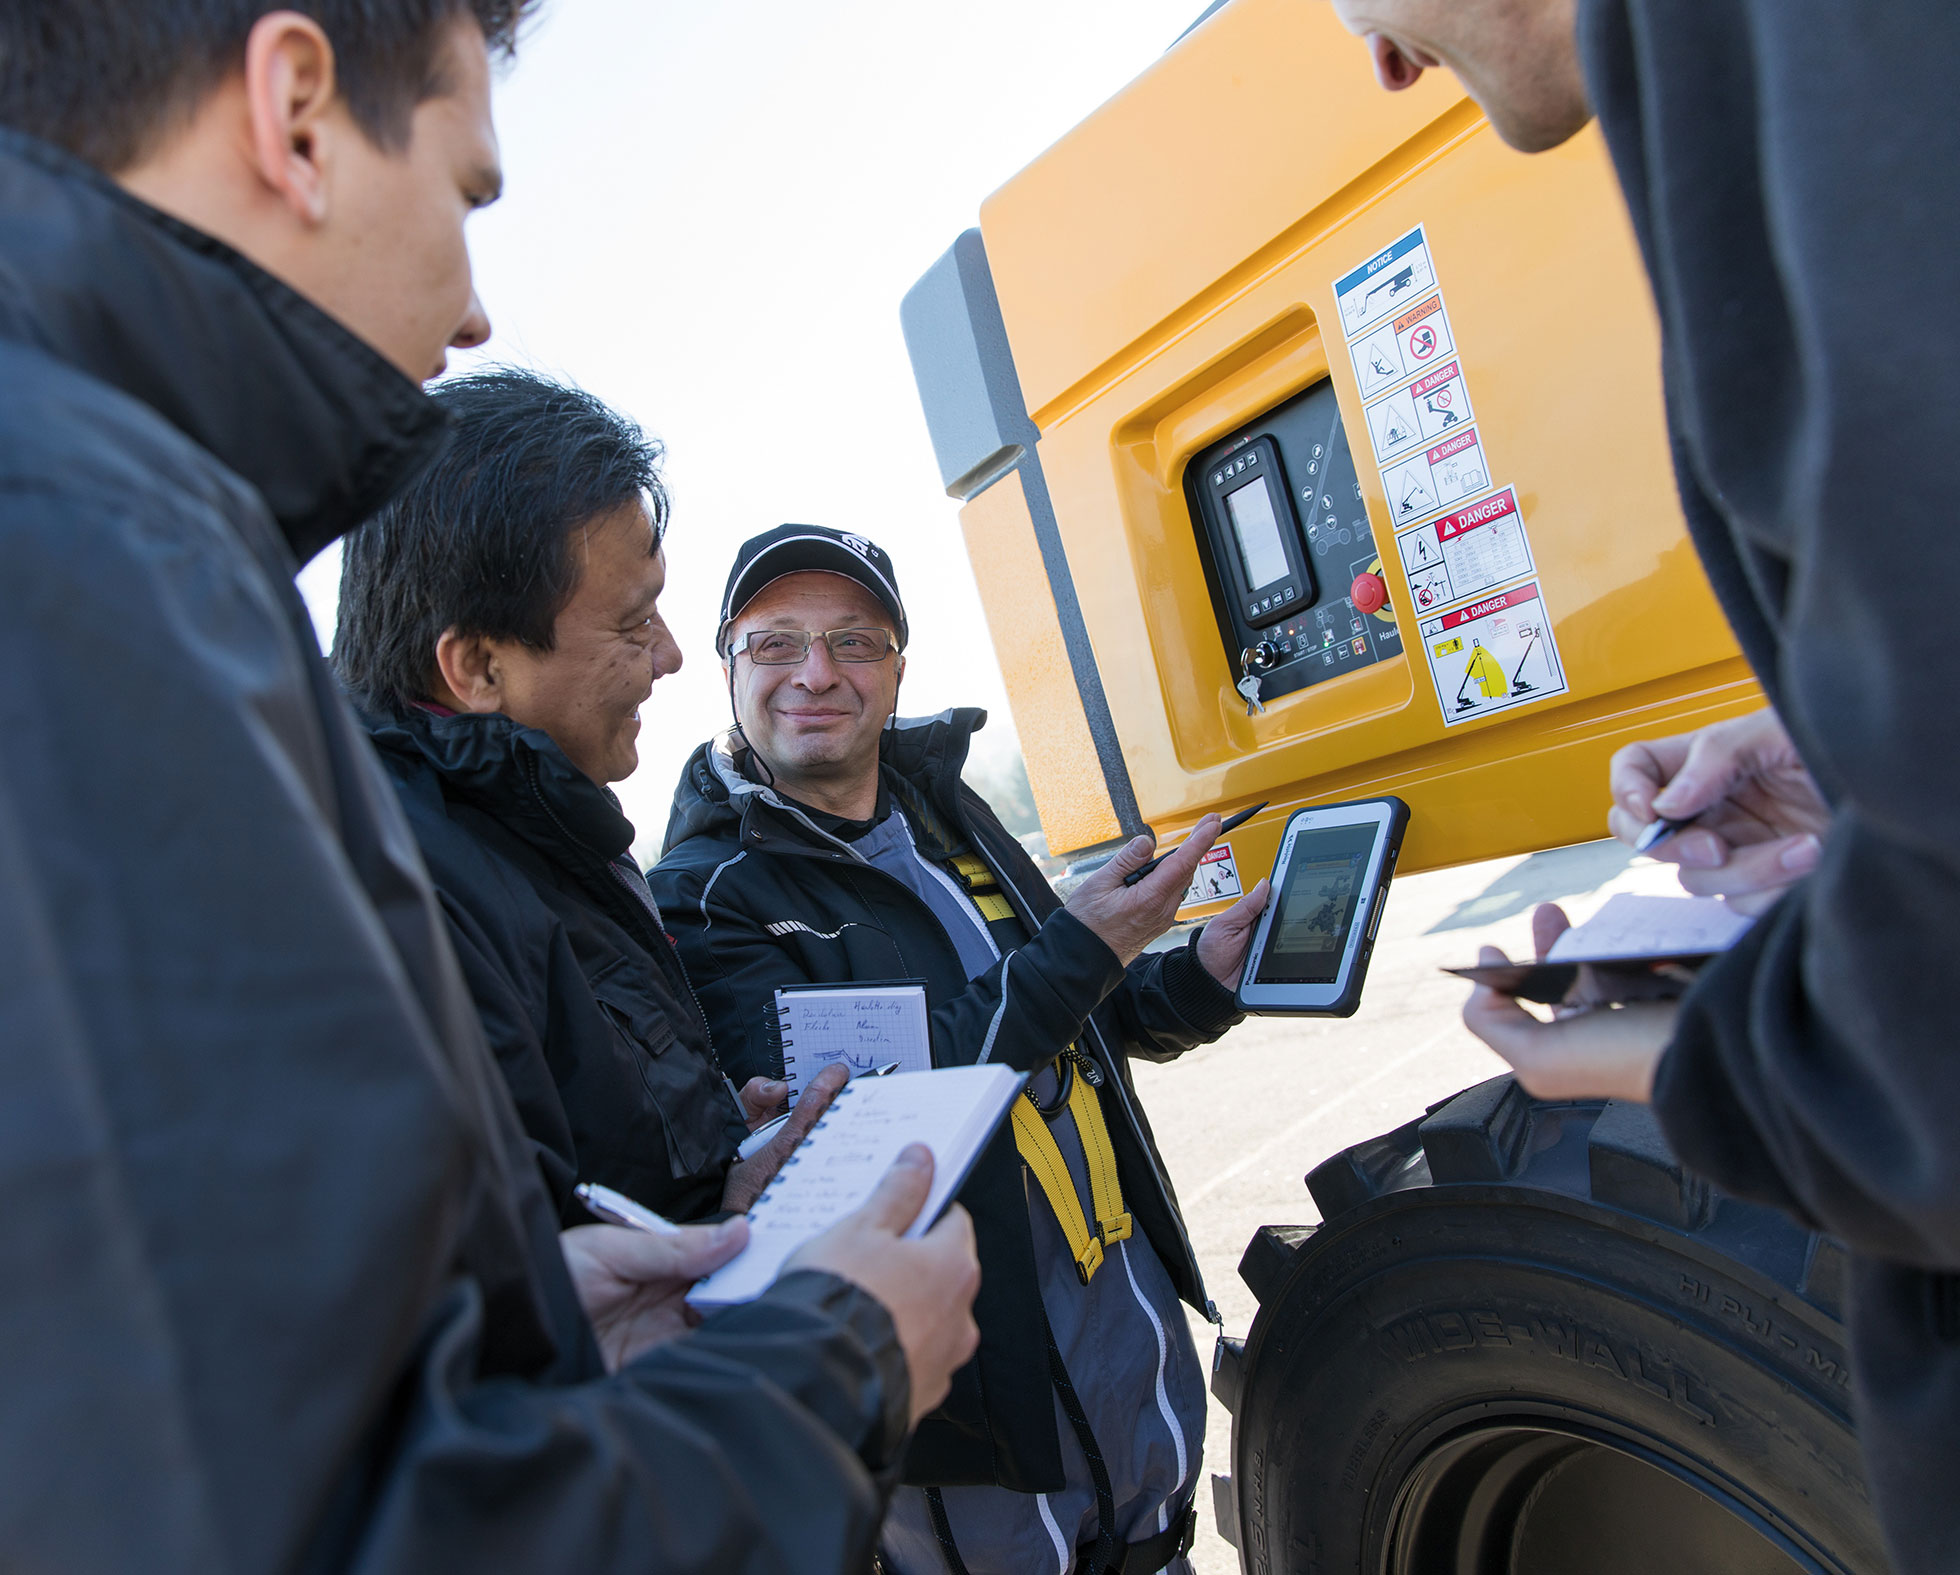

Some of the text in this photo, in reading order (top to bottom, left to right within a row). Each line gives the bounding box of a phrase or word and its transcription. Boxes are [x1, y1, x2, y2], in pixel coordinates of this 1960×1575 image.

[1367, 250, 1393, 274] NOTICE
[1406, 300, 1438, 324] WARNING
[1424, 366, 1455, 389] DANGER
[1441, 434, 1472, 456] DANGER
[1458, 498, 1508, 529] DANGER
[1470, 596, 1507, 617] DANGER
[1206, 849, 1228, 861] DANGER
[1679, 1273, 1710, 1304] HI
[1343, 1408, 1392, 1493] TUBELESS
